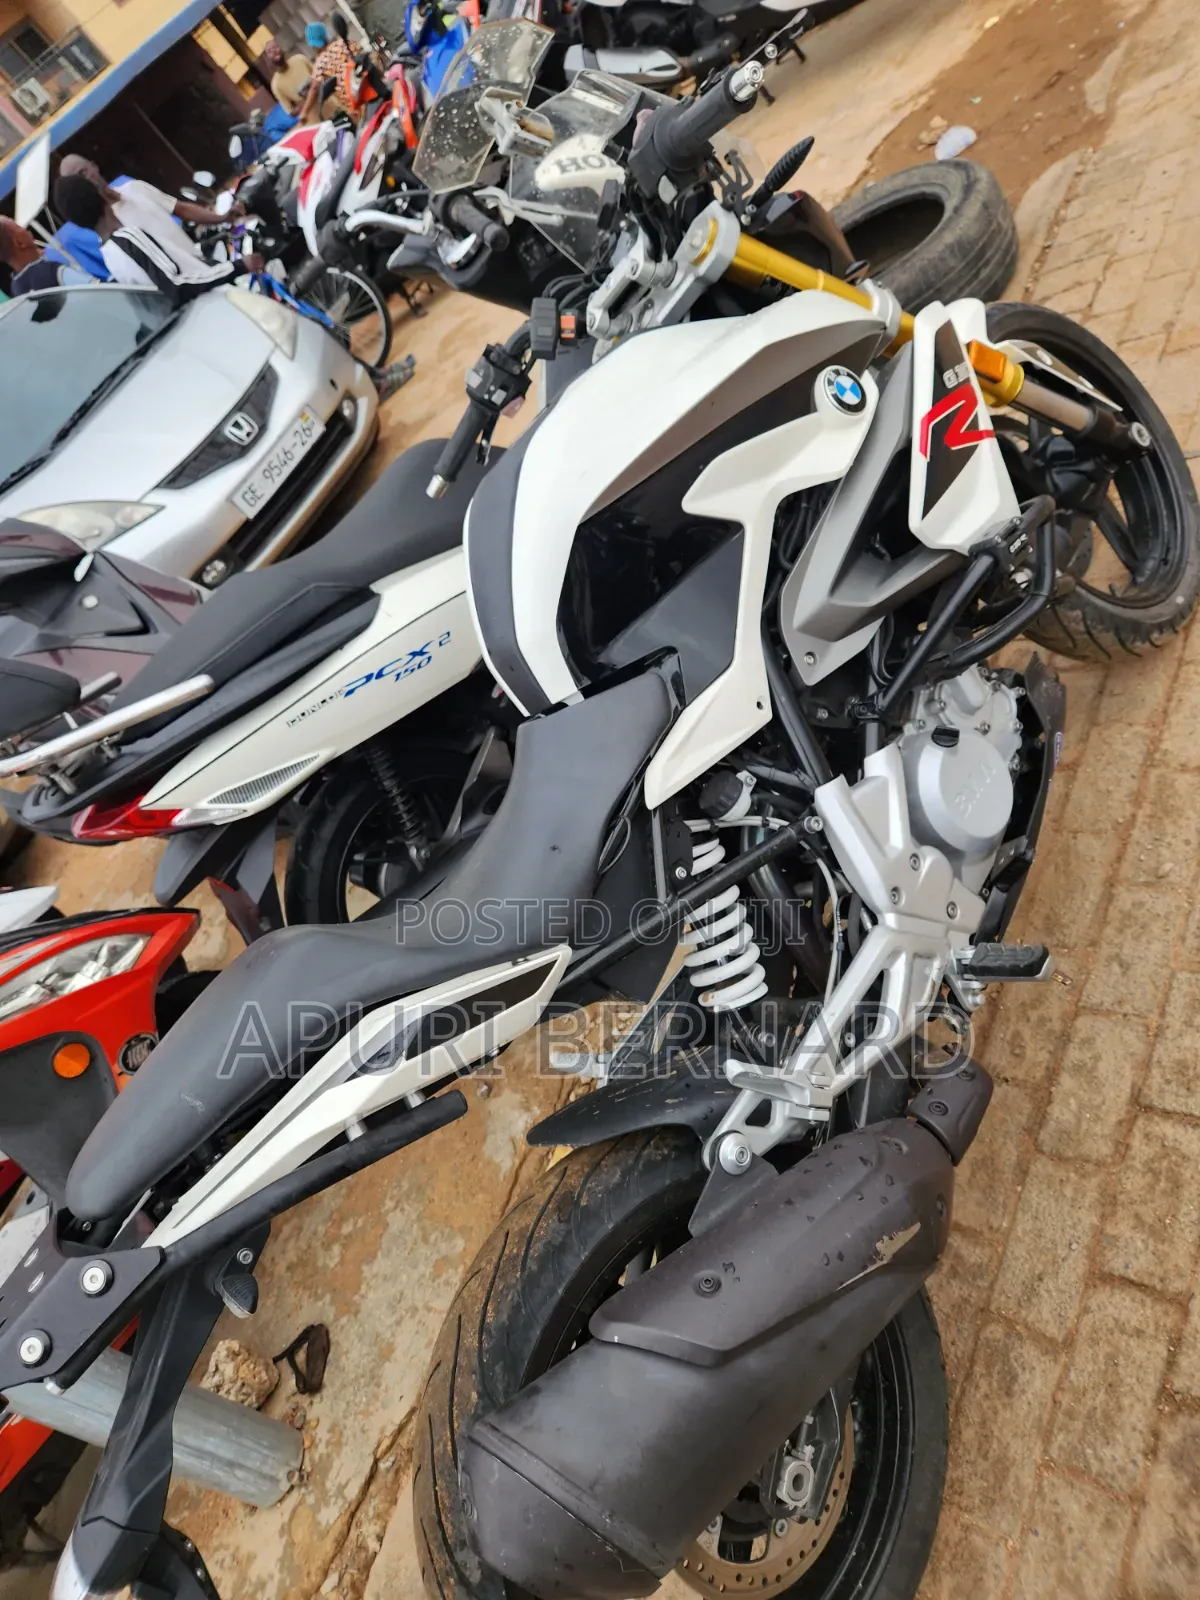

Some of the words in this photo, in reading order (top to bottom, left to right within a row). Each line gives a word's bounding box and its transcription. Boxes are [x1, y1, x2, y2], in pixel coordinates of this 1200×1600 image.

[242, 483, 264, 507] GE
[344, 640, 435, 698] PCX
[394, 655, 432, 683] 150
